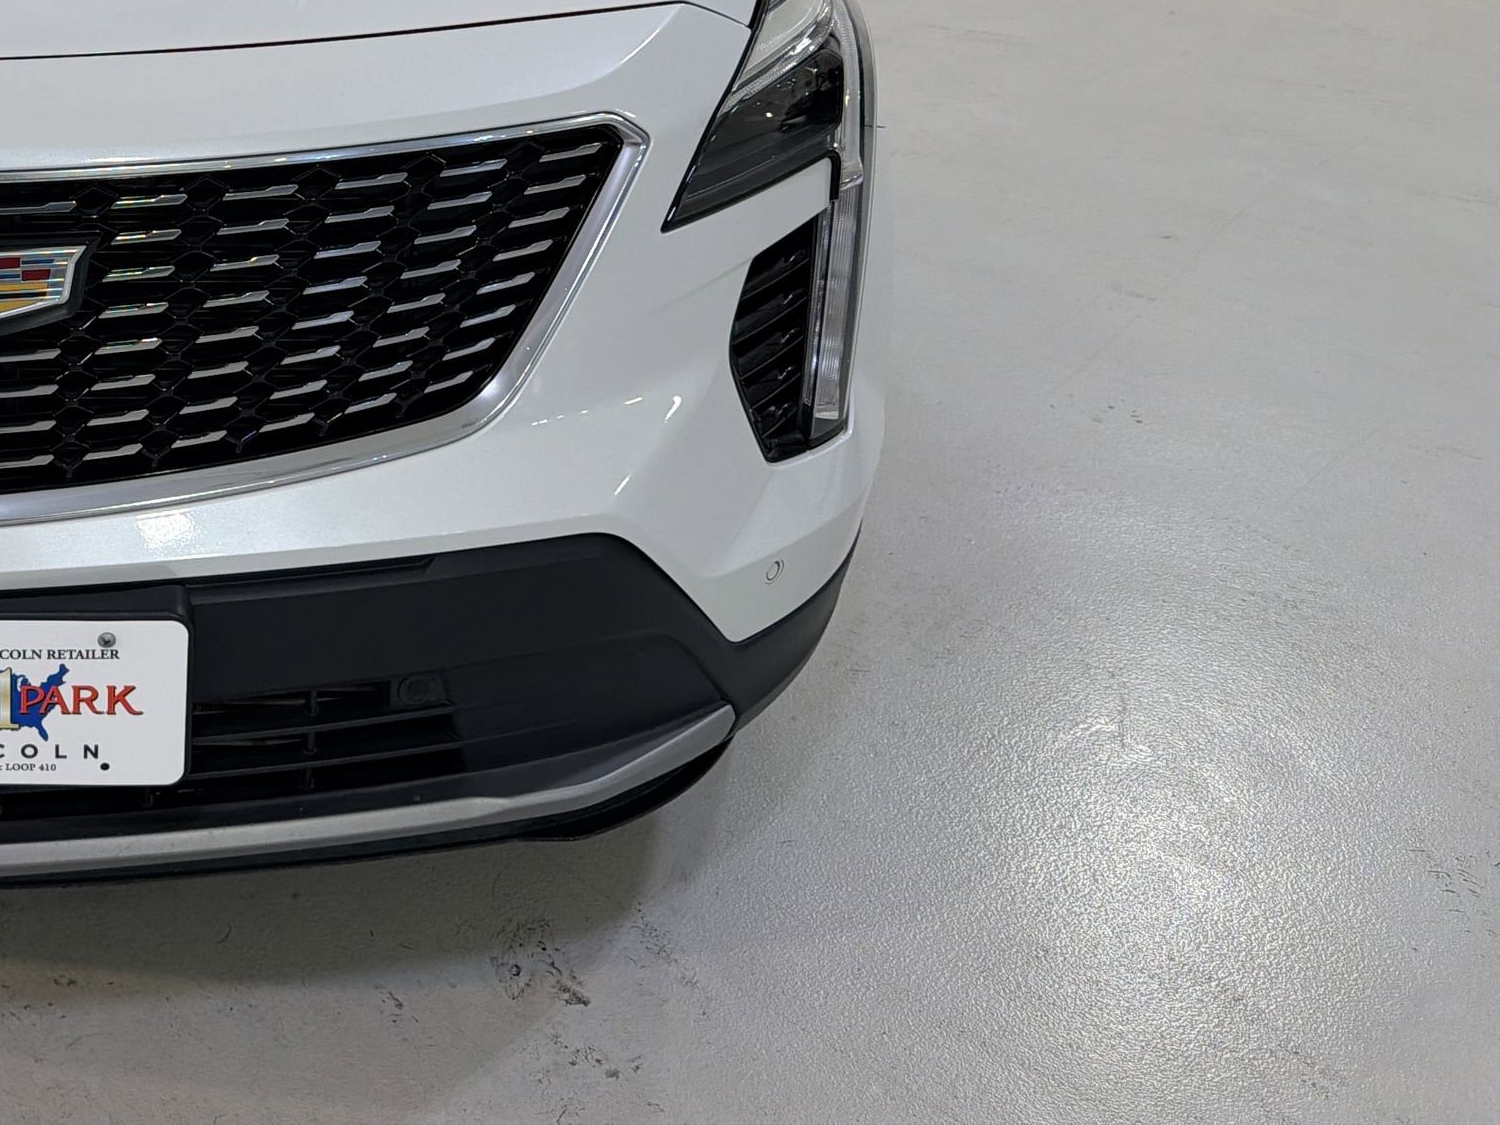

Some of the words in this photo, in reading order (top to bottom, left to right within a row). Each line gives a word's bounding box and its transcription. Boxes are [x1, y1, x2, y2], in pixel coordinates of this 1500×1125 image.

[46, 649, 120, 660] RETAILER
[19, 685, 144, 716] PARK
[5, 762, 36, 771] LOOP
[38, 762, 57, 771] 410
